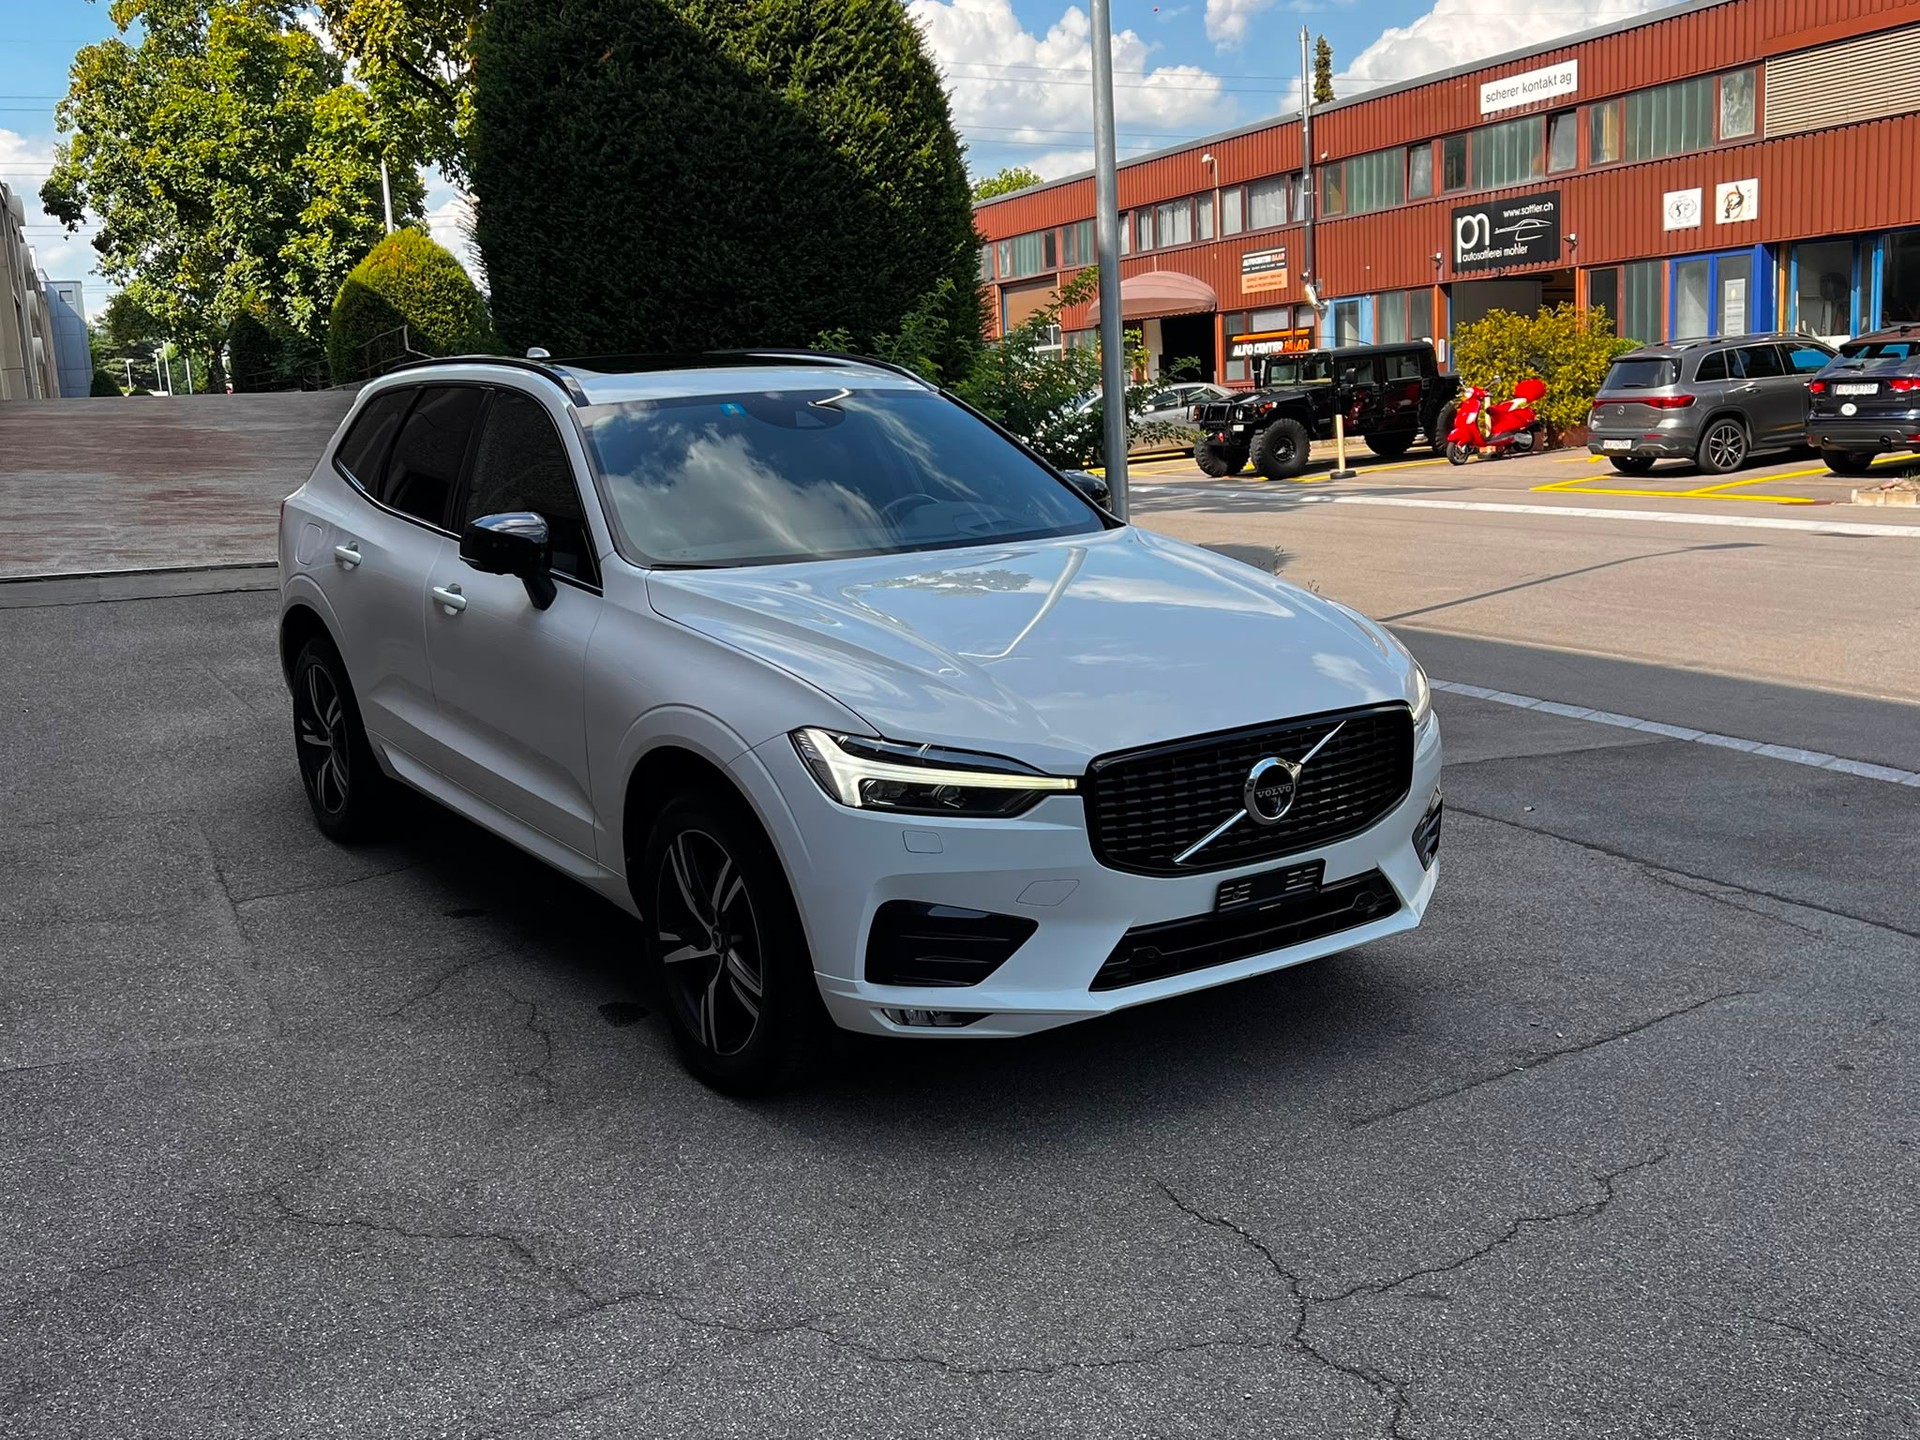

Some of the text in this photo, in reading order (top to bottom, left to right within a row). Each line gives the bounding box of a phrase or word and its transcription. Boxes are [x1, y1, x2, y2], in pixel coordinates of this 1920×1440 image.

[1485, 72, 1572, 103] scherer kontakt ag
[1462, 243, 1528, 261] autosattlerei mohler
[1256, 785, 1291, 797] VOLVO
